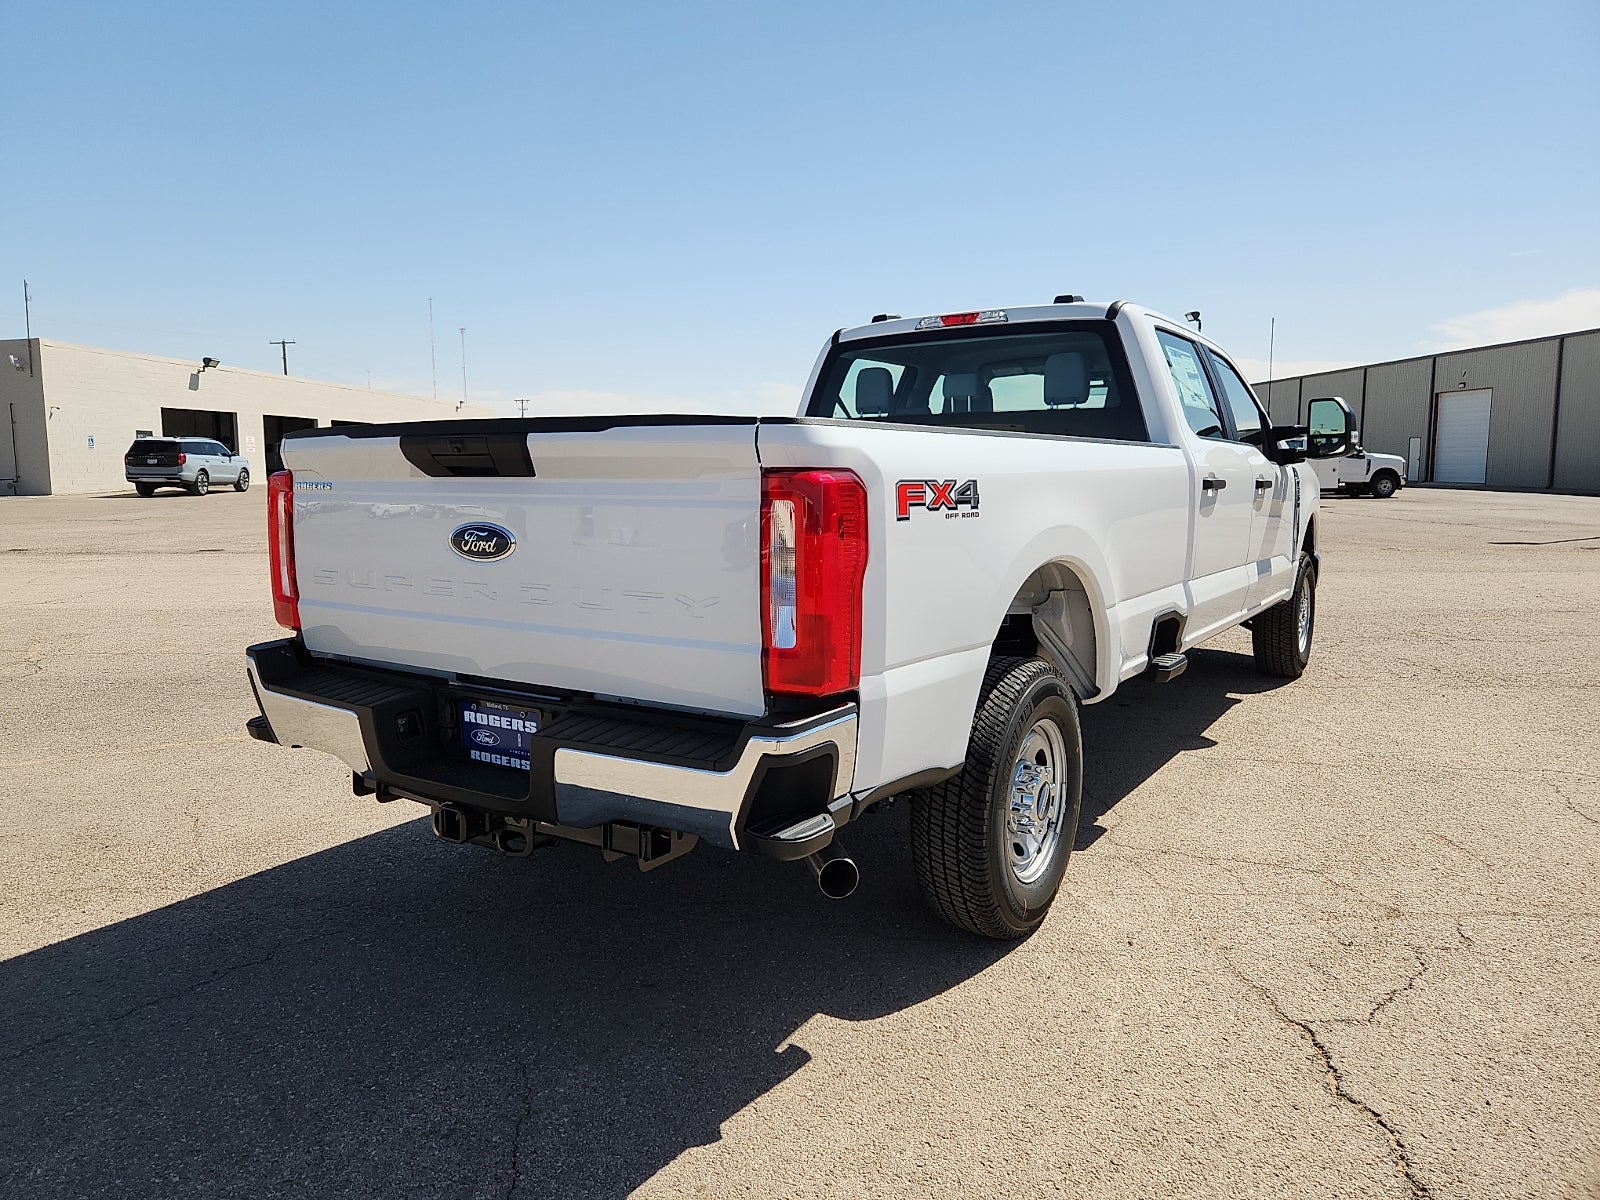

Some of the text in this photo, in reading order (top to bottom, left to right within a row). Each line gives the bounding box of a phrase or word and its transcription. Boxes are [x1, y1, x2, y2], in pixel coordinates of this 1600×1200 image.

[294, 481, 333, 491] ROGERS
[895, 479, 979, 521] FX4
[945, 511, 980, 520] OFF ROAD
[461, 530, 498, 553] Ford
[313, 567, 720, 619] SUPER DUTY
[463, 710, 538, 734] ROGERS
[476, 731, 495, 744] Ford
[470, 749, 531, 771] ROGERS
